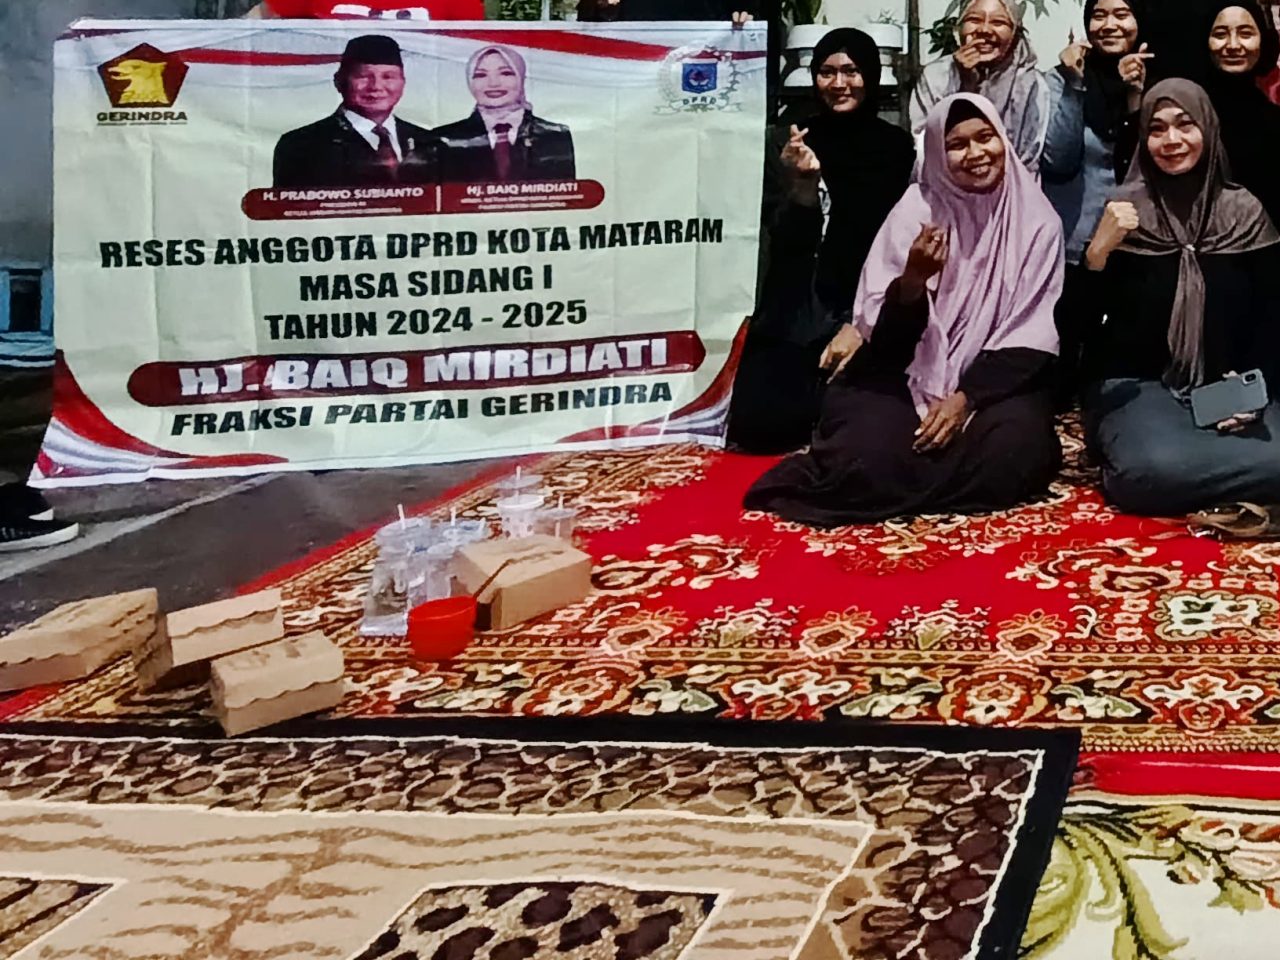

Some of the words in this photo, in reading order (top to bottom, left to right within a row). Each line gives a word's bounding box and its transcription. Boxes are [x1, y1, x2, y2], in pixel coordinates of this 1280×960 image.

[96, 111, 187, 122] GERINDRA
[682, 96, 716, 105] DPRD
[263, 192, 277, 201] H.
[280, 190, 350, 200] PRABOWO
[354, 187, 423, 198] SUBIANTO
[487, 185, 518, 194] BAIQ
[521, 182, 578, 193] MIRDIATI
[101, 239, 205, 268] RESES
[214, 234, 377, 265] ANGGOTA
[386, 230, 478, 260] DPRD
[487, 226, 571, 254] KOTA
[579, 218, 723, 250] MATARAM
[300, 272, 399, 301] MASA
[408, 266, 533, 297] SIDANG
[543, 264, 553, 289] I
[264, 311, 377, 340] TAHUN
[387, 306, 473, 335] 2024
[502, 299, 588, 328] 2025
[179, 363, 259, 396] HJ.
[270, 357, 409, 390] BAIQ
[423, 338, 668, 383] MIRDIATI
[170, 405, 313, 436] FRAKSI
[324, 398, 469, 425] PARTAI
[481, 382, 673, 417] GERINDRA
